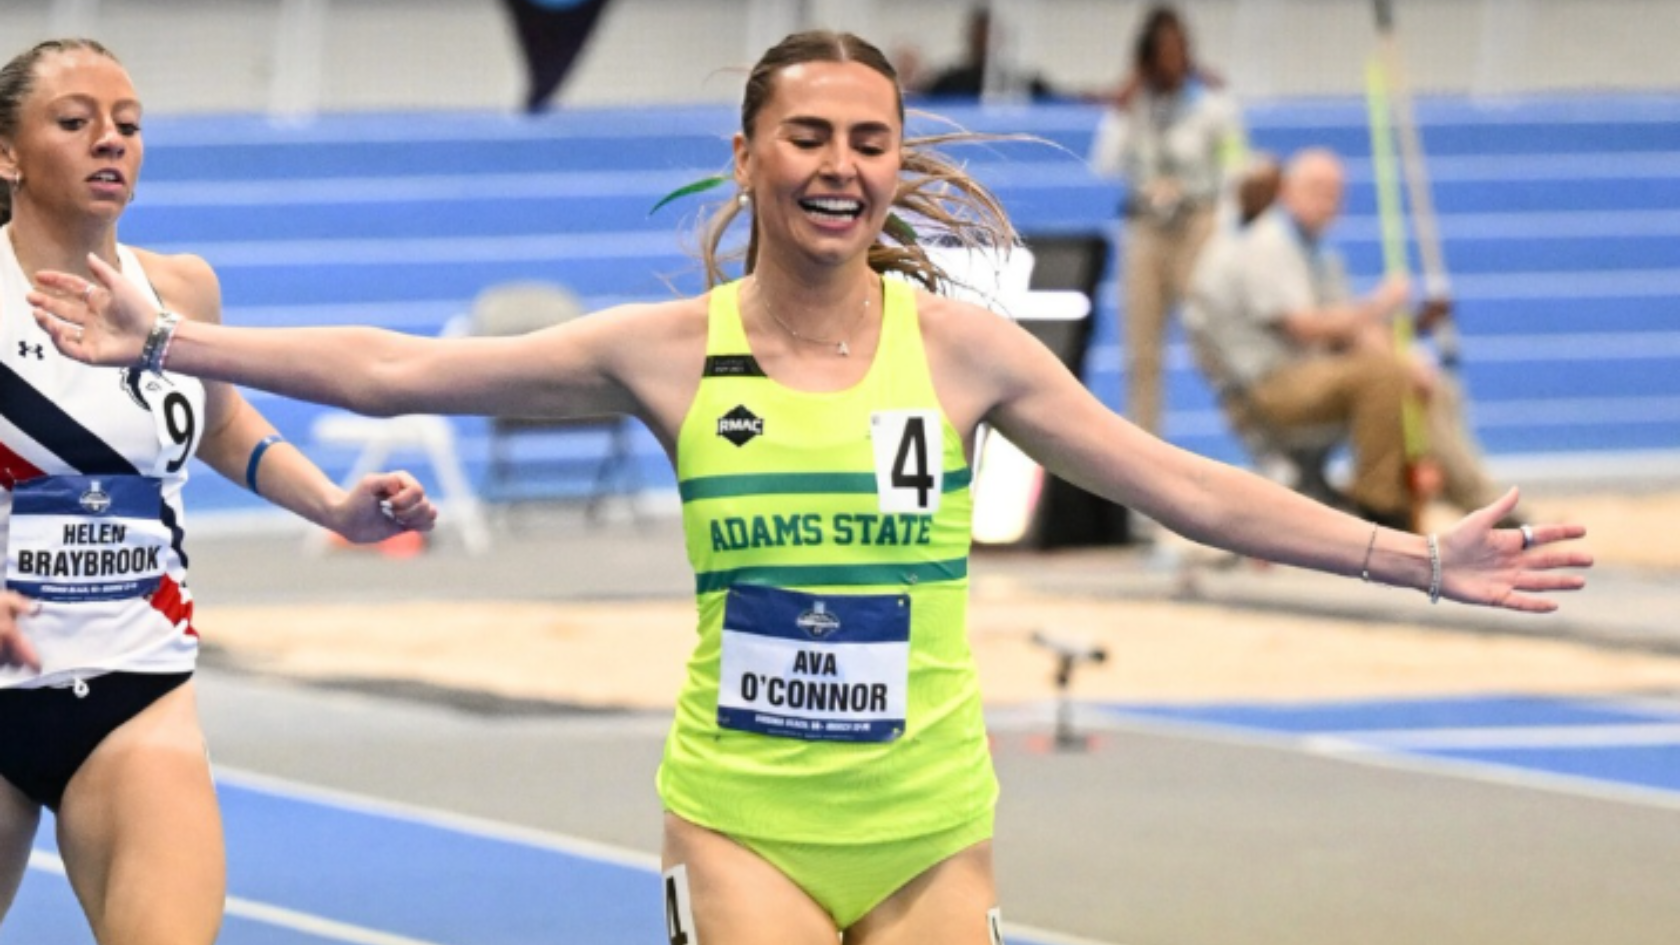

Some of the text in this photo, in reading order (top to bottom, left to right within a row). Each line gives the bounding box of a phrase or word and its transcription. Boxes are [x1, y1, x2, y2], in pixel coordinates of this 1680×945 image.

[163, 391, 195, 473] 9
[719, 419, 763, 434] RMAC
[891, 416, 934, 508] 4
[63, 523, 126, 545] HELEN
[710, 513, 932, 552] ADAMS STATE
[18, 545, 161, 577] BRAYBROOK
[793, 650, 837, 676] AVA
[741, 672, 888, 712] O'CONNOR
